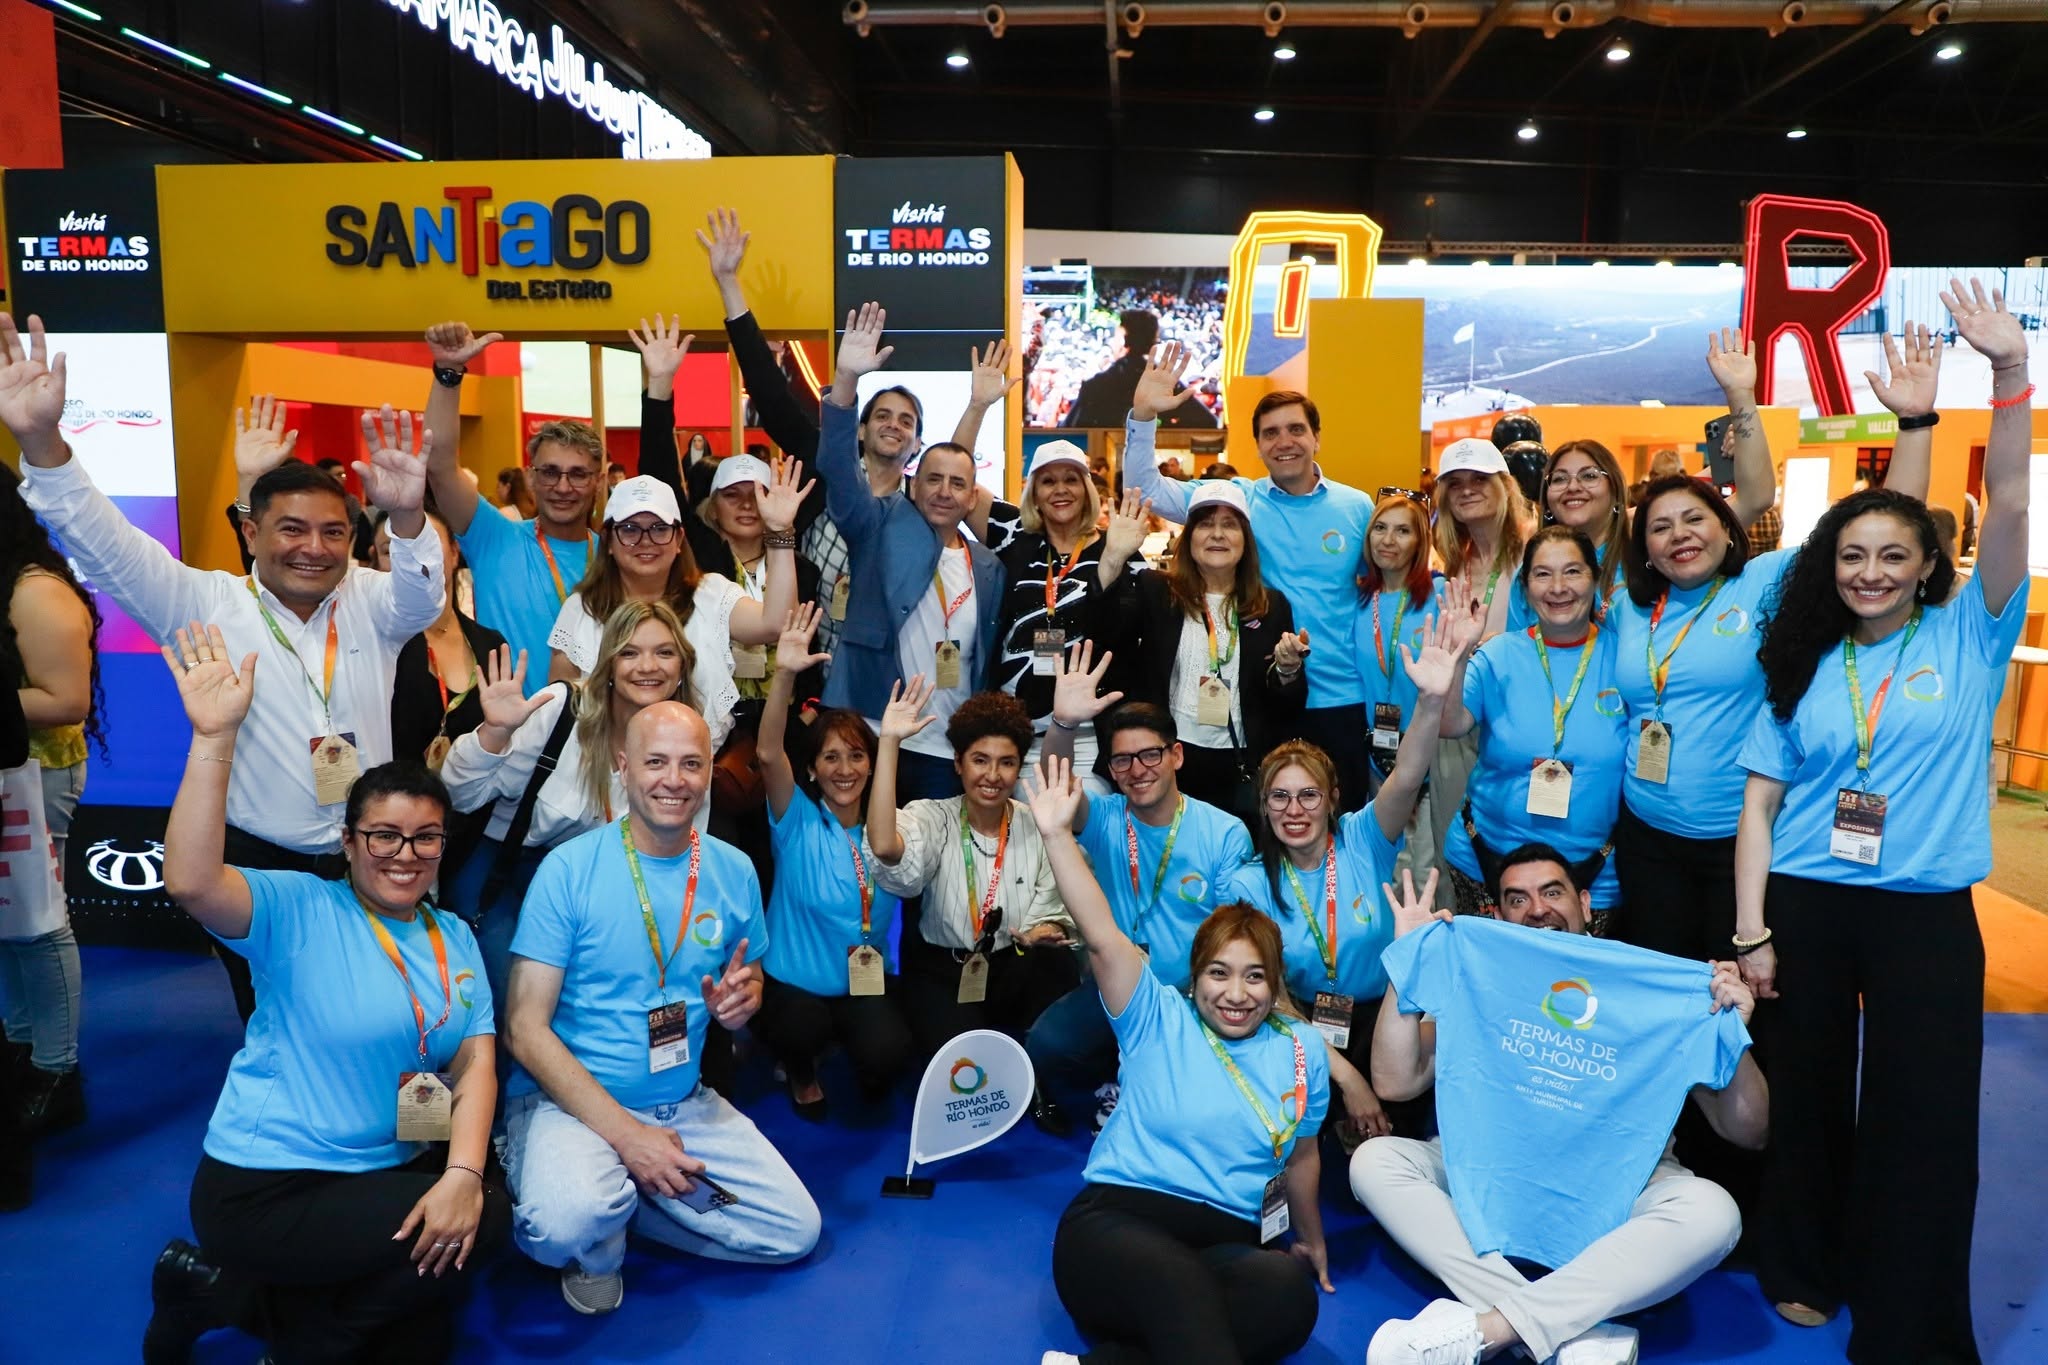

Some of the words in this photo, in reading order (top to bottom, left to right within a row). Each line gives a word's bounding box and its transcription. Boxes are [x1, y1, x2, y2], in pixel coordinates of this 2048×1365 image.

[59, 210, 108, 231] Visitá
[892, 200, 947, 224] Visitá
[18, 235, 150, 257] TERMAS
[845, 227, 991, 251] TERMAS
[22, 259, 46, 272] DE
[49, 259, 81, 272] RIO
[85, 259, 149, 272] HONDO
[847, 252, 874, 266] DE
[878, 252, 914, 266] RIO
[918, 251, 990, 266] HONDO
[1840, 823, 1875, 833] EXPOSITOR
[1509, 1019, 1586, 1053] TERMAS
[1591, 1042, 1618, 1063] DE
[1501, 1035, 1535, 1057] RÍO
[1541, 1047, 1617, 1081] HONDO
[945, 1094, 988, 1112] TERMAS
[990, 1089, 1006, 1101] DE
[968, 1100, 1010, 1118] HONDO
